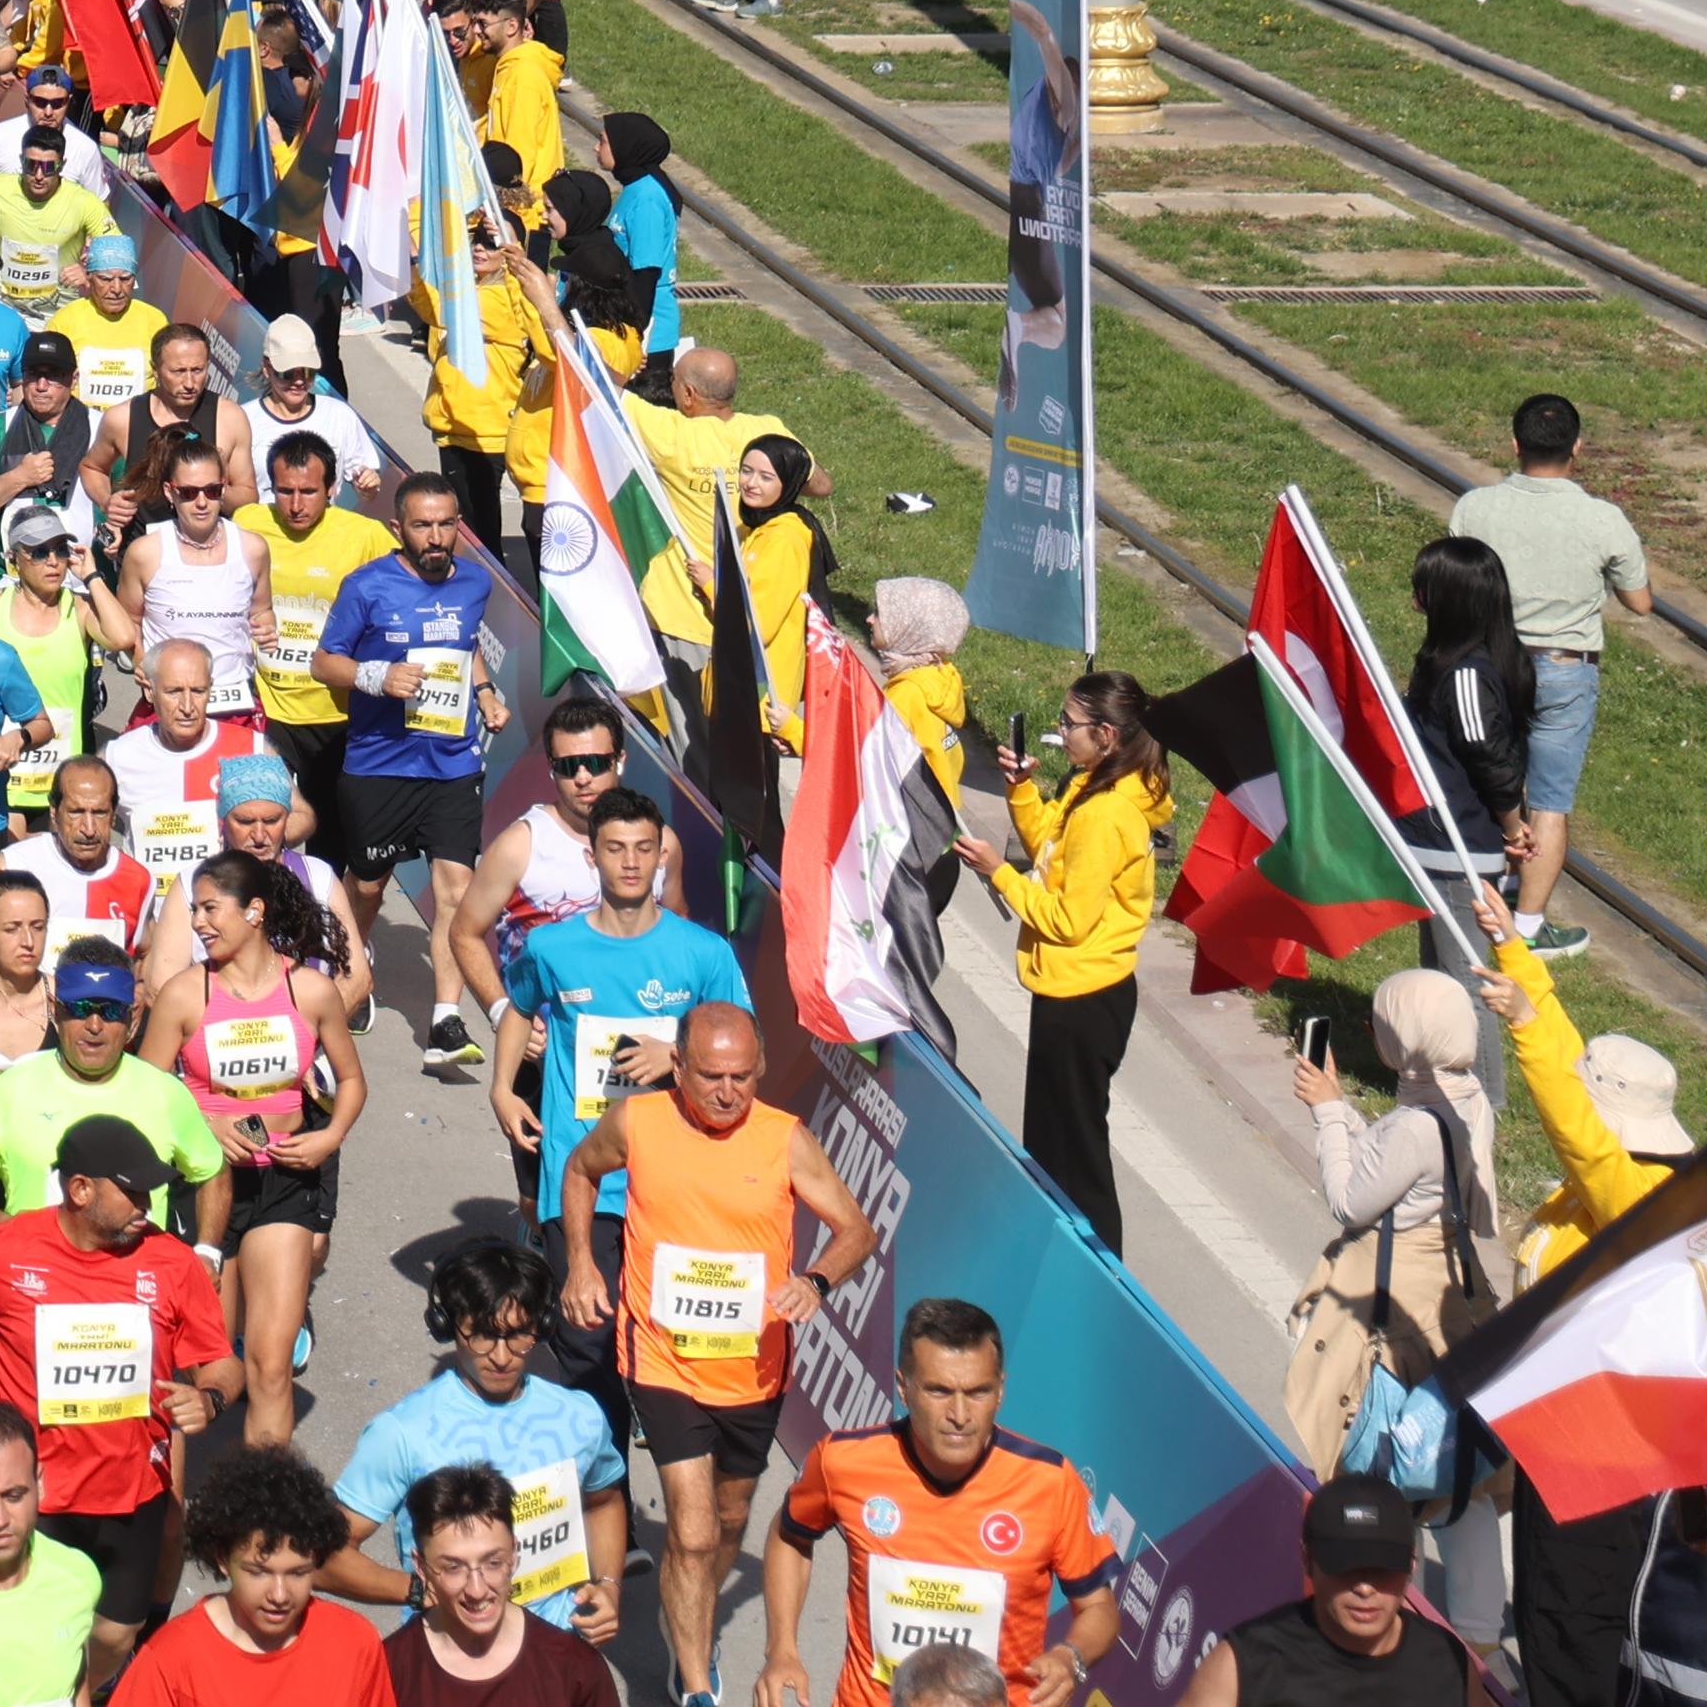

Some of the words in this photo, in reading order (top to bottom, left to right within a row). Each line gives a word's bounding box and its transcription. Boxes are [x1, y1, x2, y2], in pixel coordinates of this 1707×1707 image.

[6, 267, 52, 282] 10296
[89, 383, 133, 397] 11087
[144, 844, 208, 862] 12482
[219, 1056, 287, 1077] 10614
[674, 1296, 742, 1320] 11815
[53, 1364, 137, 1386] 10470
[513, 1521, 569, 1563] 460
[908, 1579, 961, 1593] KONYA
[890, 1595, 977, 1613] MARATONU
[891, 1622, 972, 1647] 10141
